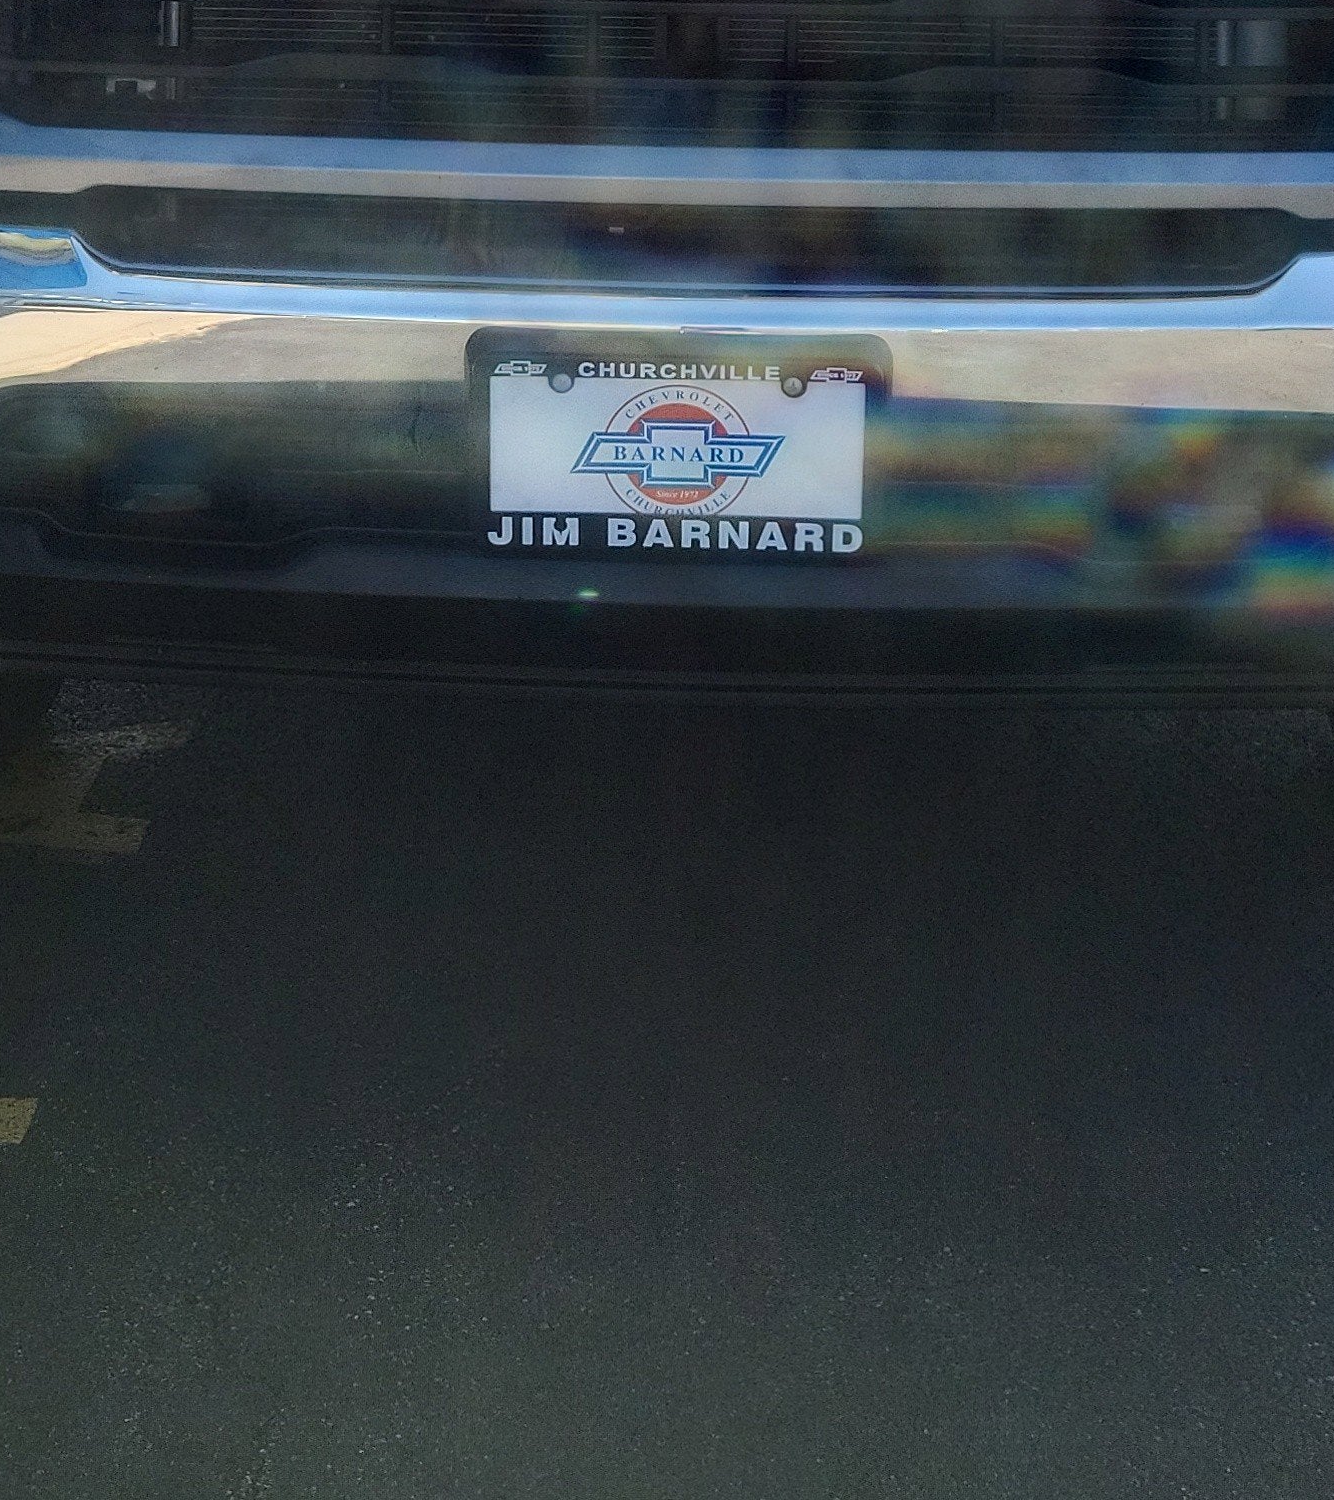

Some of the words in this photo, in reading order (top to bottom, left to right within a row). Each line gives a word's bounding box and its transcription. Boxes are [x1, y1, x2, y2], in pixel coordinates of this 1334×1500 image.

[578, 361, 781, 381] CHURCHVILLE
[625, 390, 734, 419] CHEVROLET
[614, 445, 744, 463] BARNARD
[487, 516, 581, 547] JIM
[607, 518, 864, 554] BARNARD
